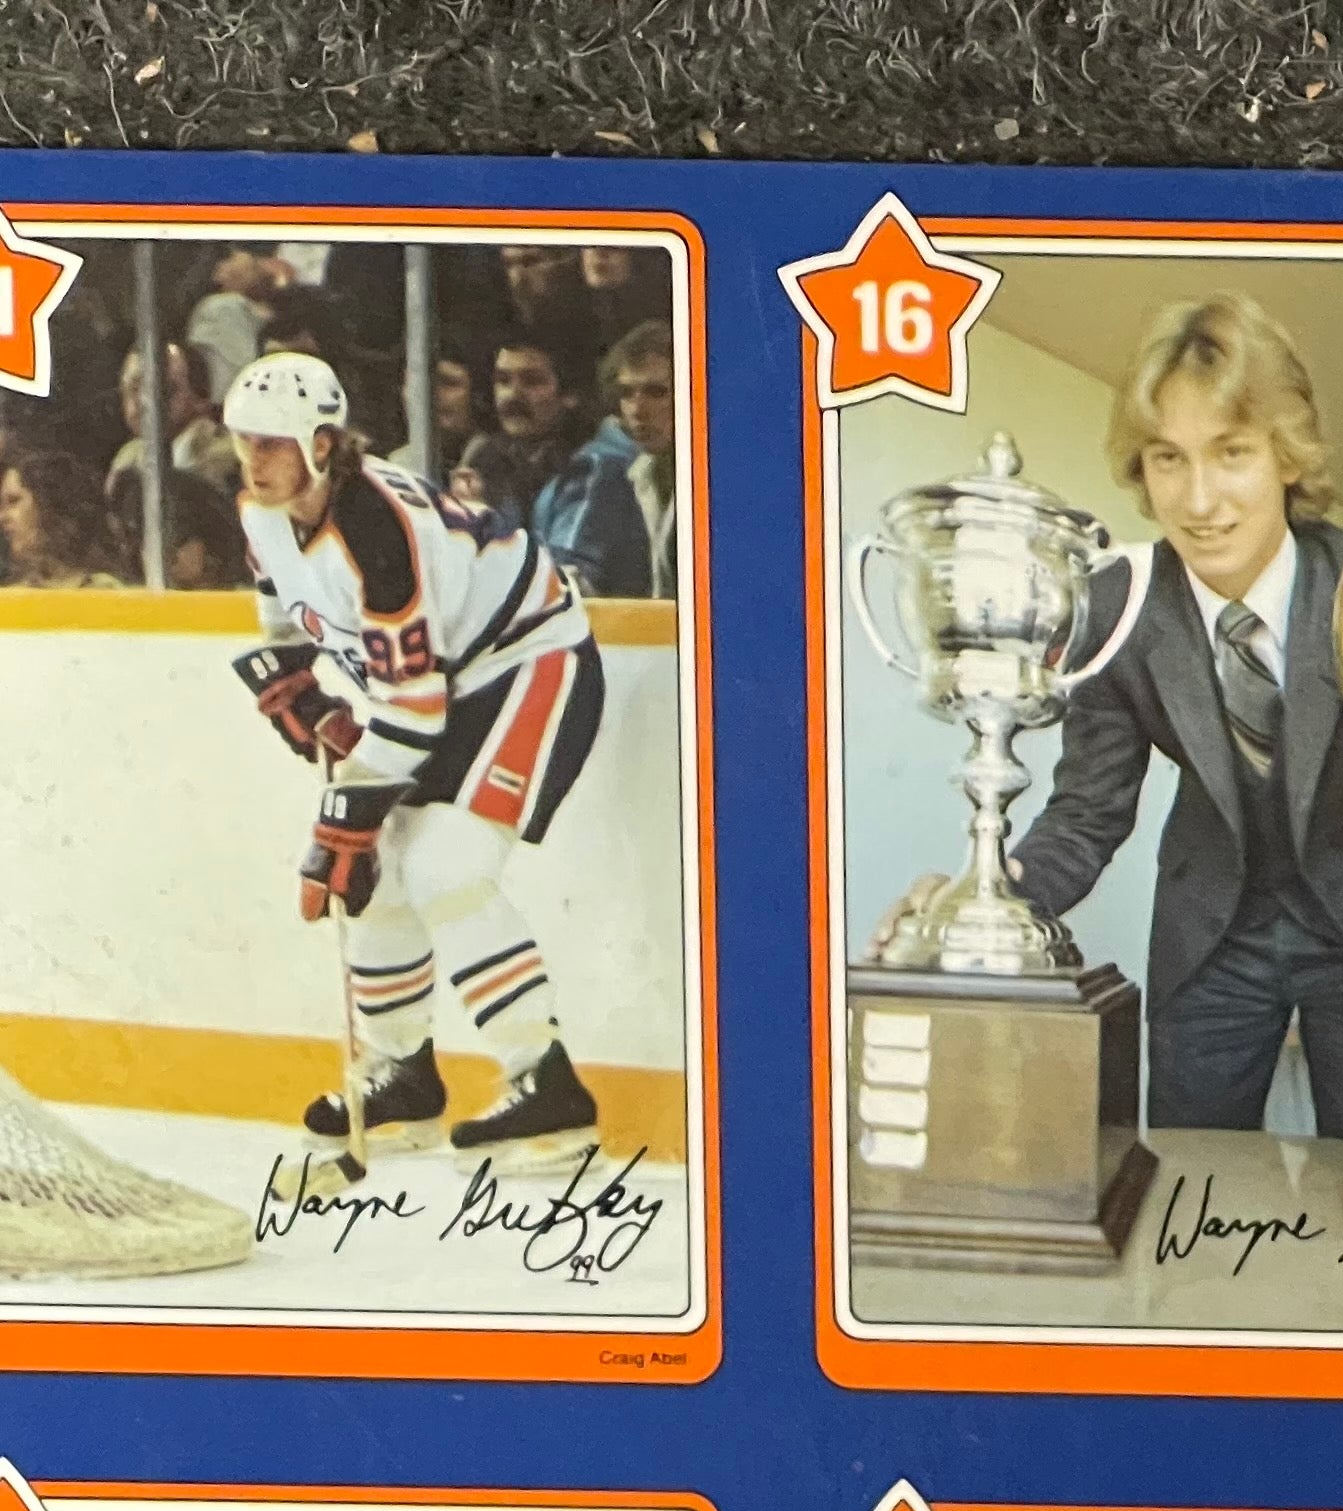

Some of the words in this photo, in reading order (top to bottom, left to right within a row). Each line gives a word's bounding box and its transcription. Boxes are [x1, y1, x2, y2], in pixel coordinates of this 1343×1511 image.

[851, 280, 934, 354] 16
[257, 1154, 425, 1252] Wayne
[1156, 1174, 1326, 1274] Wayne
[599, 1350, 644, 1369] Craig
[650, 1352, 687, 1365] Abel
